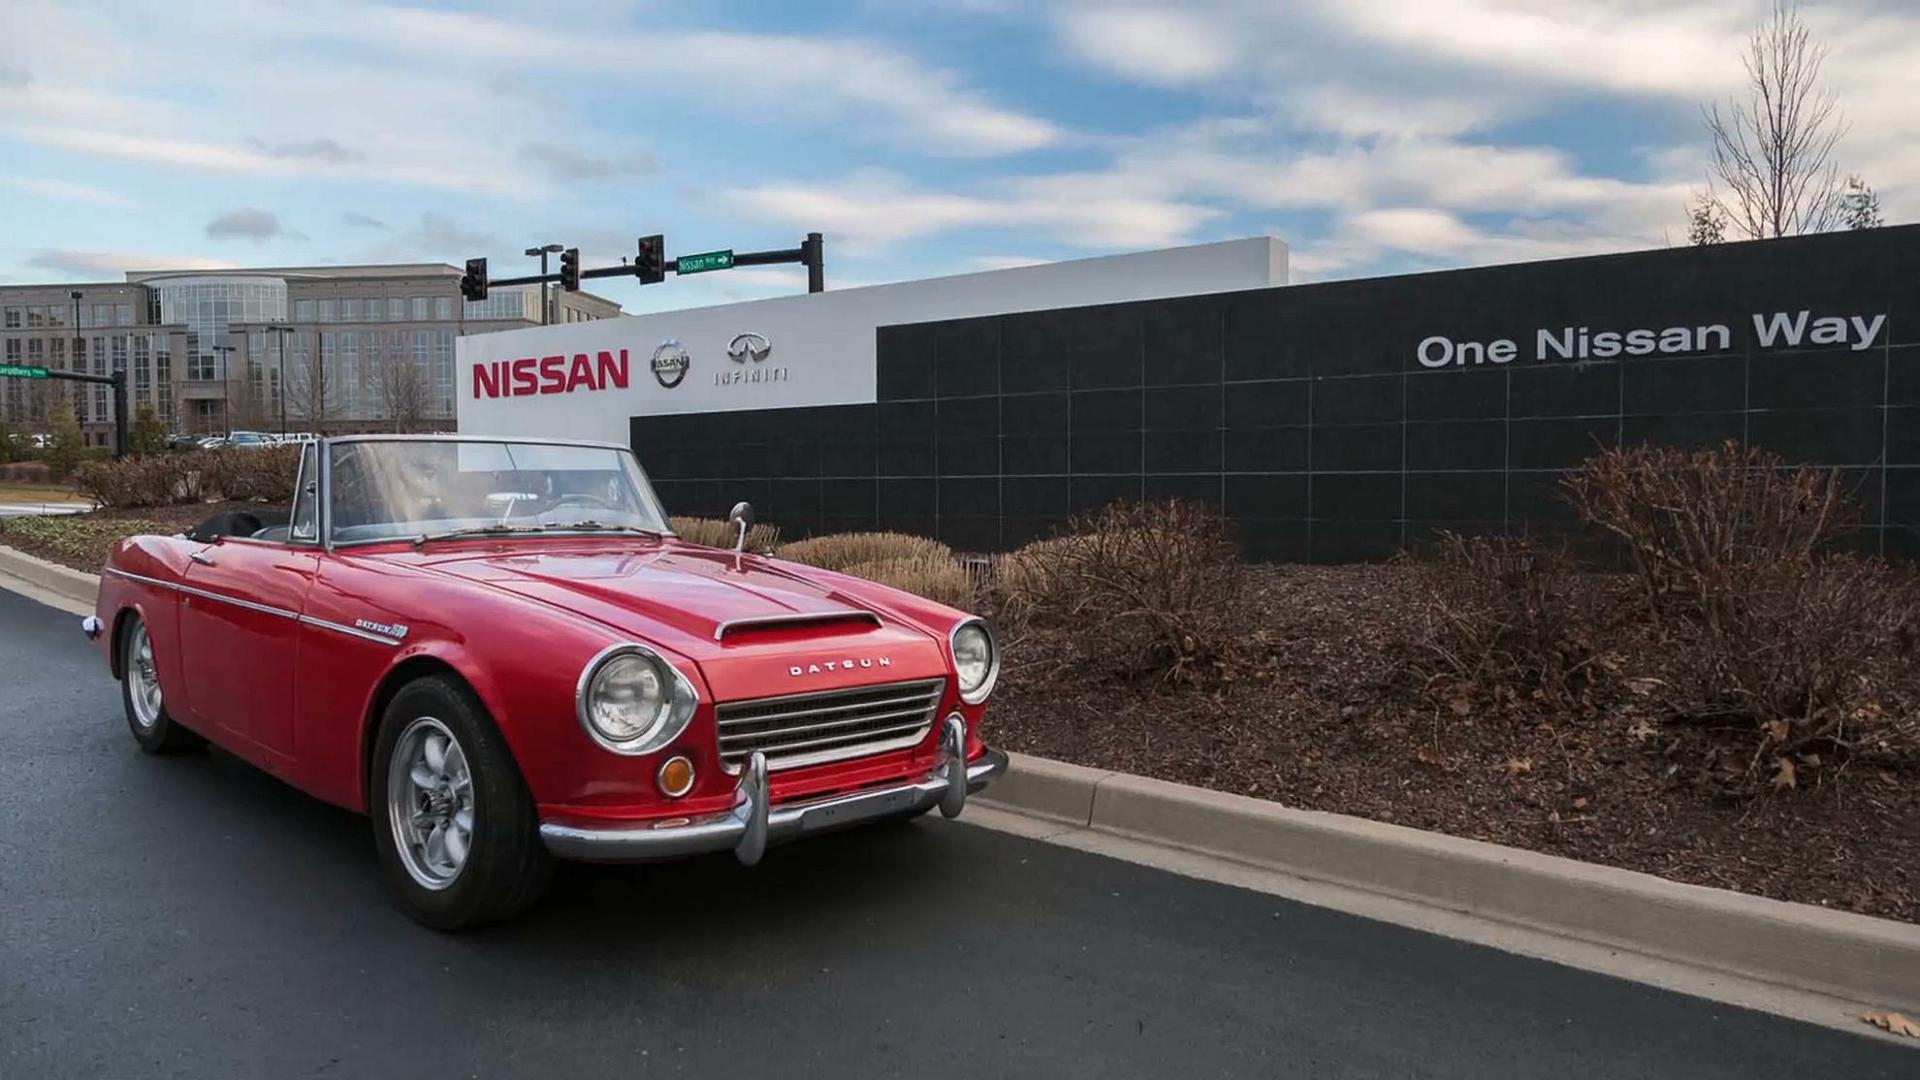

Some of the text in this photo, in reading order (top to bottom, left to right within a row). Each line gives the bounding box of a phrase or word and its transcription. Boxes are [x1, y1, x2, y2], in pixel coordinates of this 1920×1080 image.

[679, 258, 704, 272] Nissan
[1416, 309, 1887, 369] One Nissan Way
[472, 349, 629, 400] NISSAN
[713, 366, 788, 387] INFINITI
[789, 657, 891, 675] DATSUN
